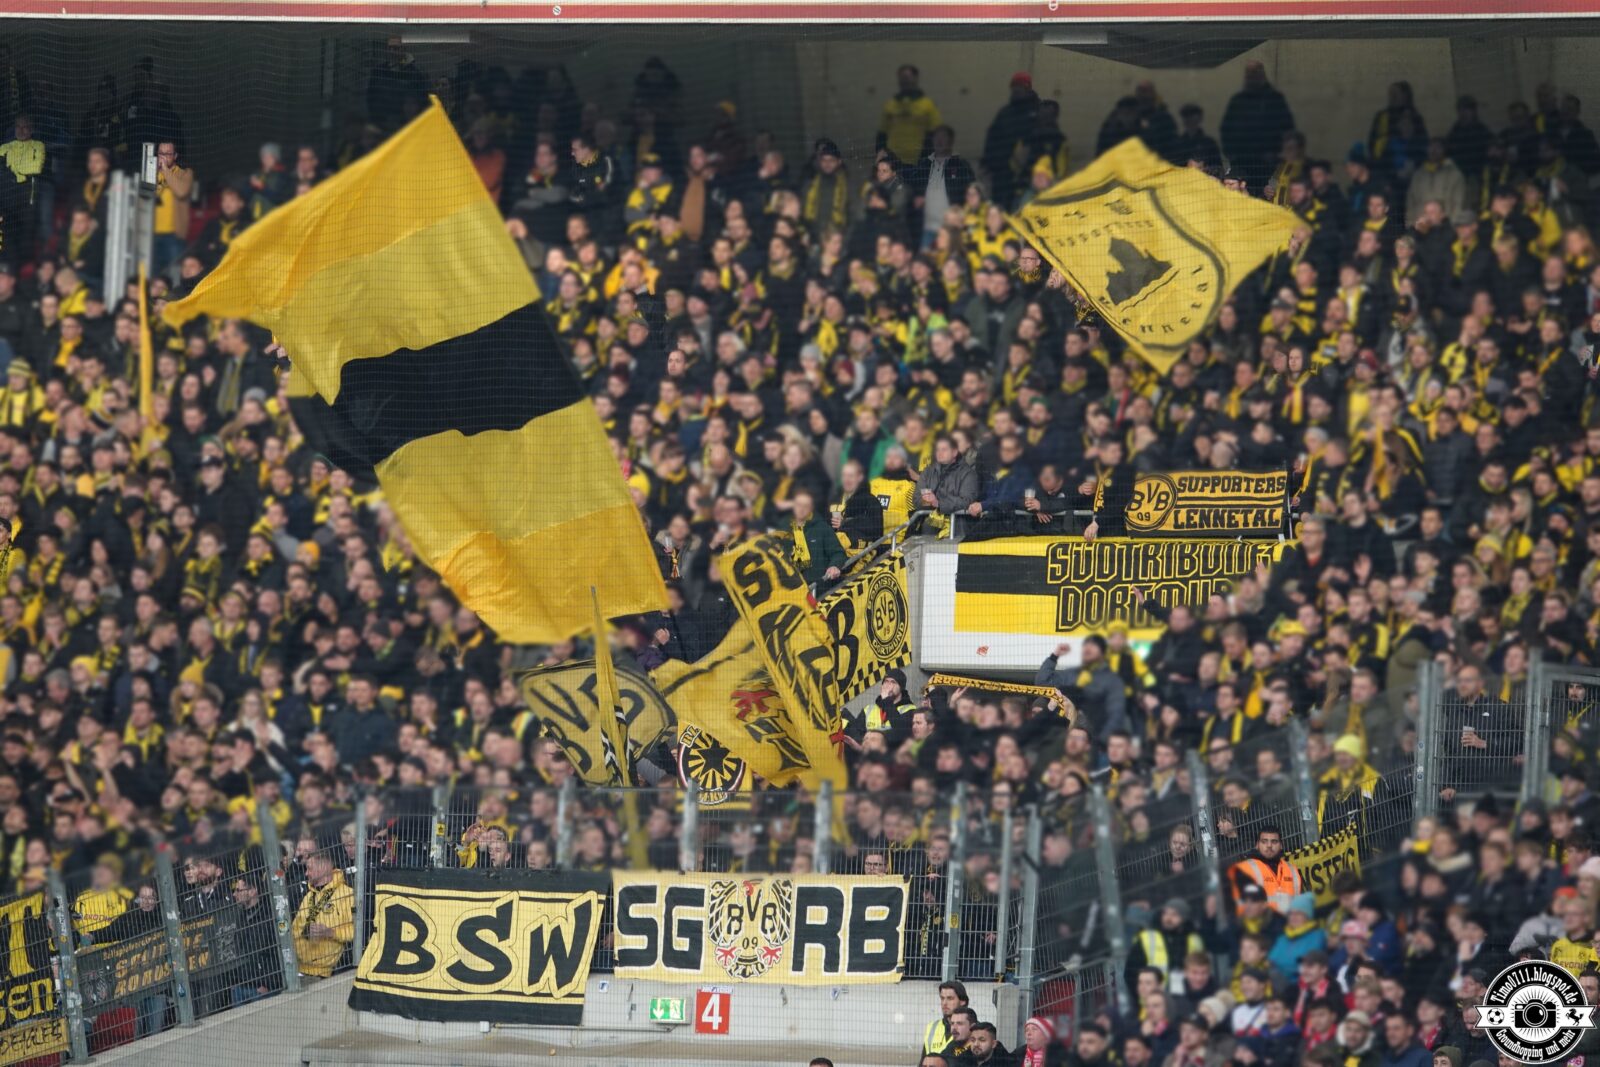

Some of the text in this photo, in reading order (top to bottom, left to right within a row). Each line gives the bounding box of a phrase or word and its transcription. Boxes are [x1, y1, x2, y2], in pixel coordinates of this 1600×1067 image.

[1127, 482, 1171, 511] BVB
[1176, 476, 1287, 493] SUPPORTERS
[1136, 512, 1151, 521] 09
[1173, 508, 1281, 529] LENNETAL
[875, 593, 896, 631] BVB
[1058, 578, 1234, 633] DORTMU
[872, 621, 905, 655] DORTMUND
[371, 899, 593, 990] BSW
[616, 885, 904, 973] SG BVB RB
[741, 937, 759, 950] 09
[114, 950, 210, 999] BORUSEN
[701, 993, 723, 1031] 4
